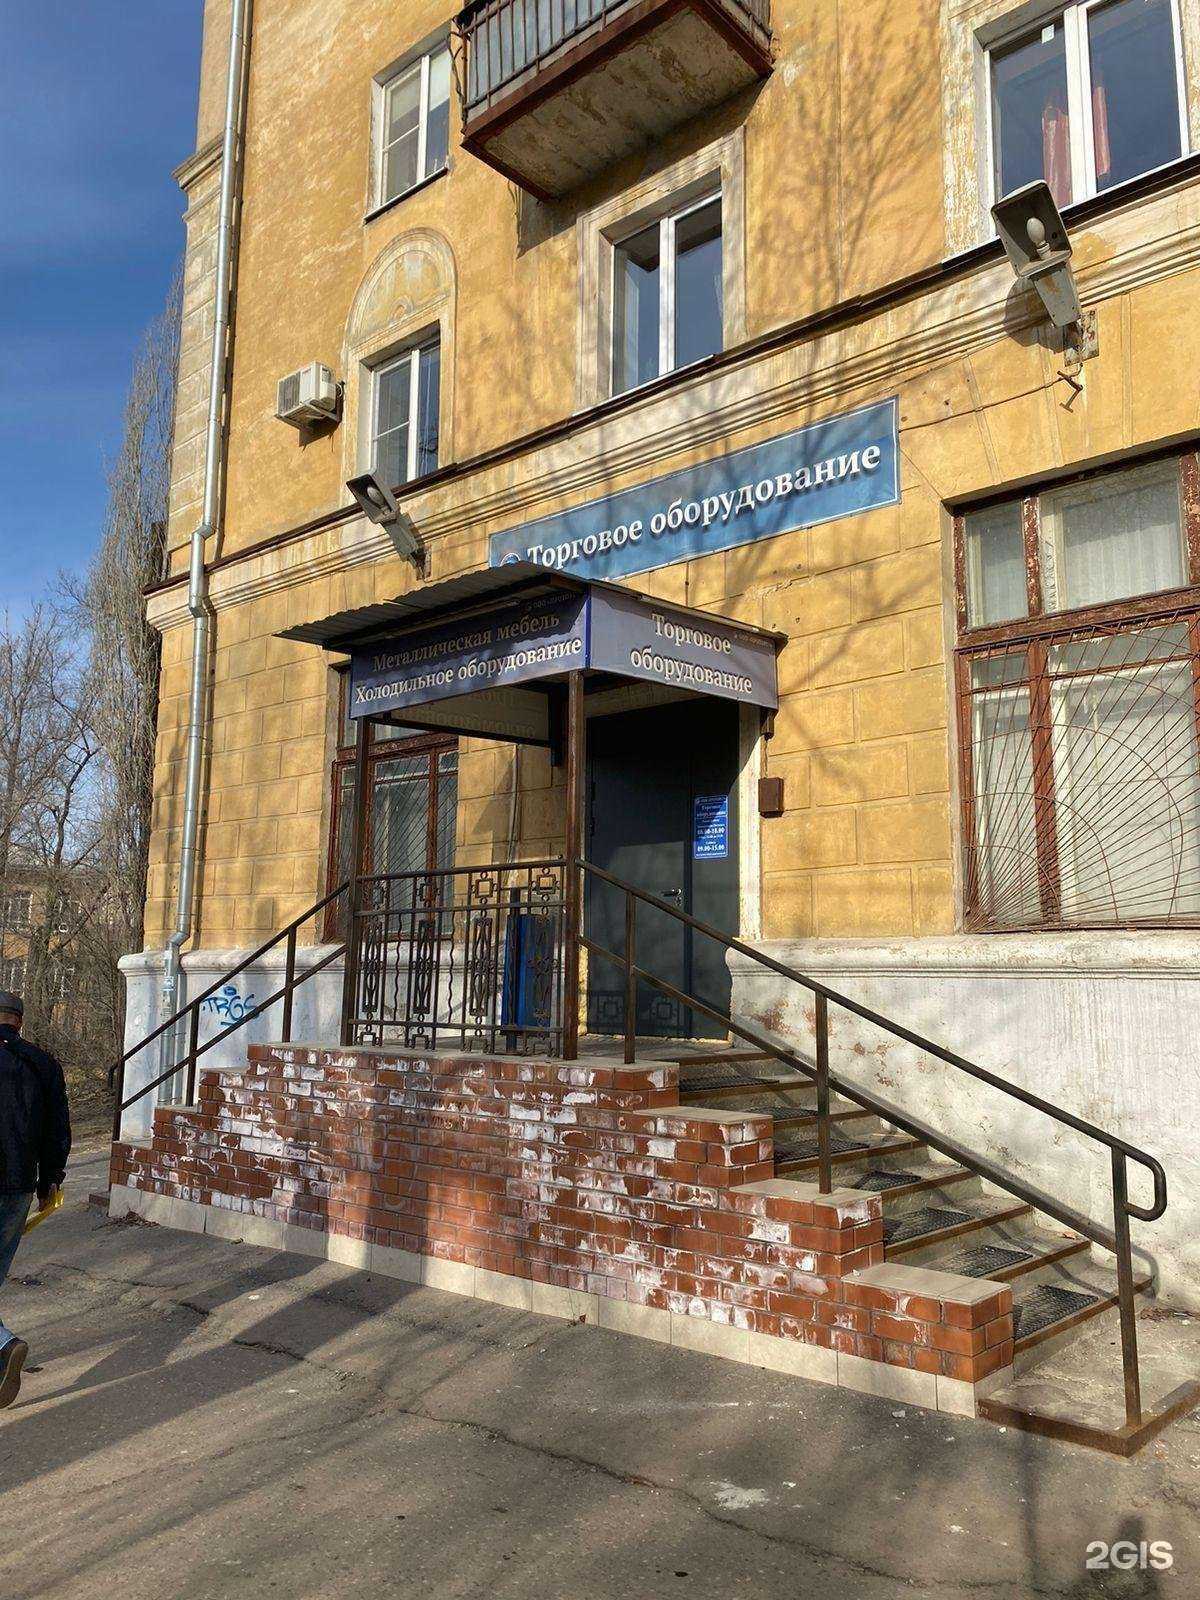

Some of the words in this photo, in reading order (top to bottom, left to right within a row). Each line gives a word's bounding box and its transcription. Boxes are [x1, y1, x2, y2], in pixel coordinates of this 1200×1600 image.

[527, 520, 642, 570] Торговое
[650, 444, 881, 536] оборудование
[373, 629, 492, 673] Металлическая
[496, 613, 560, 642] мебель
[651, 613, 732, 655] Торговое
[355, 668, 454, 704] Холодильное
[458, 637, 582, 681] оборудование
[630, 646, 753, 694] оборудование
